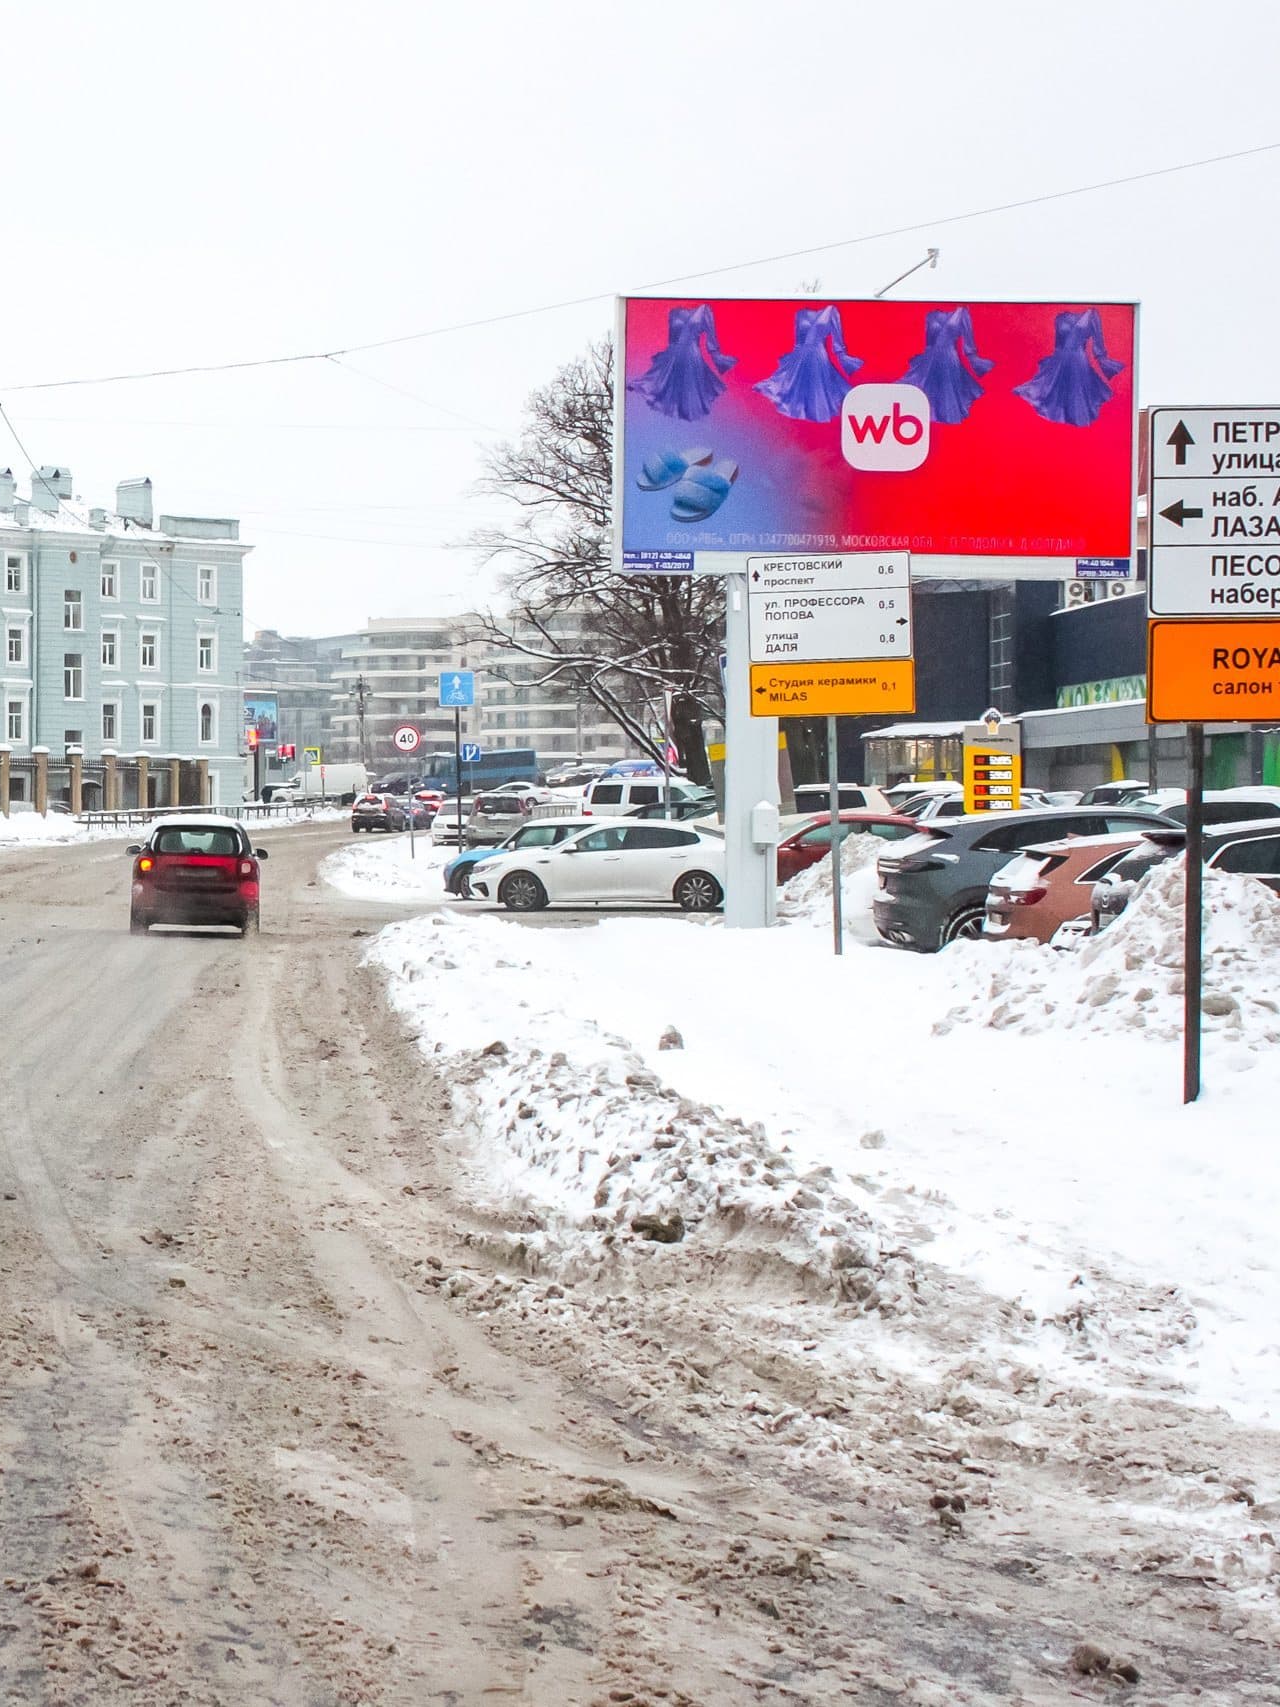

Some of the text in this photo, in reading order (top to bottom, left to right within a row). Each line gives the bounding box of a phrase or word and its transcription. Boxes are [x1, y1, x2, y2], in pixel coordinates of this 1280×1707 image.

[848, 402, 923, 445] wb
[1213, 422, 1280, 443] ПЕТР
[1212, 485, 1263, 507] наб.
[1211, 516, 1280, 537] ЛАЗА
[841, 535, 910, 548] МОСКОВСКАЯ
[763, 558, 843, 572] КРЕСТОВСКИЙ
[878, 565, 894, 575] 0,6
[1211, 554, 1280, 577] ПЕСО
[764, 577, 815, 588] проспект
[1210, 582, 1280, 608] набер
[764, 596, 865, 611] ул. ПРОФЕССОРА
[878, 600, 895, 610] 0,5
[765, 610, 814, 621] ПОПОВА
[765, 631, 799, 642] улица
[879, 634, 895, 644] 0,8
[765, 643, 798, 654] ДАЛЯ
[1213, 647, 1280, 670] ROYA
[769, 676, 877, 690] Студия керамики
[881, 682, 896, 692] 0,1
[1212, 681, 1272, 695] салон
[770, 691, 808, 702] MILAS
[400, 733, 414, 744] 40
